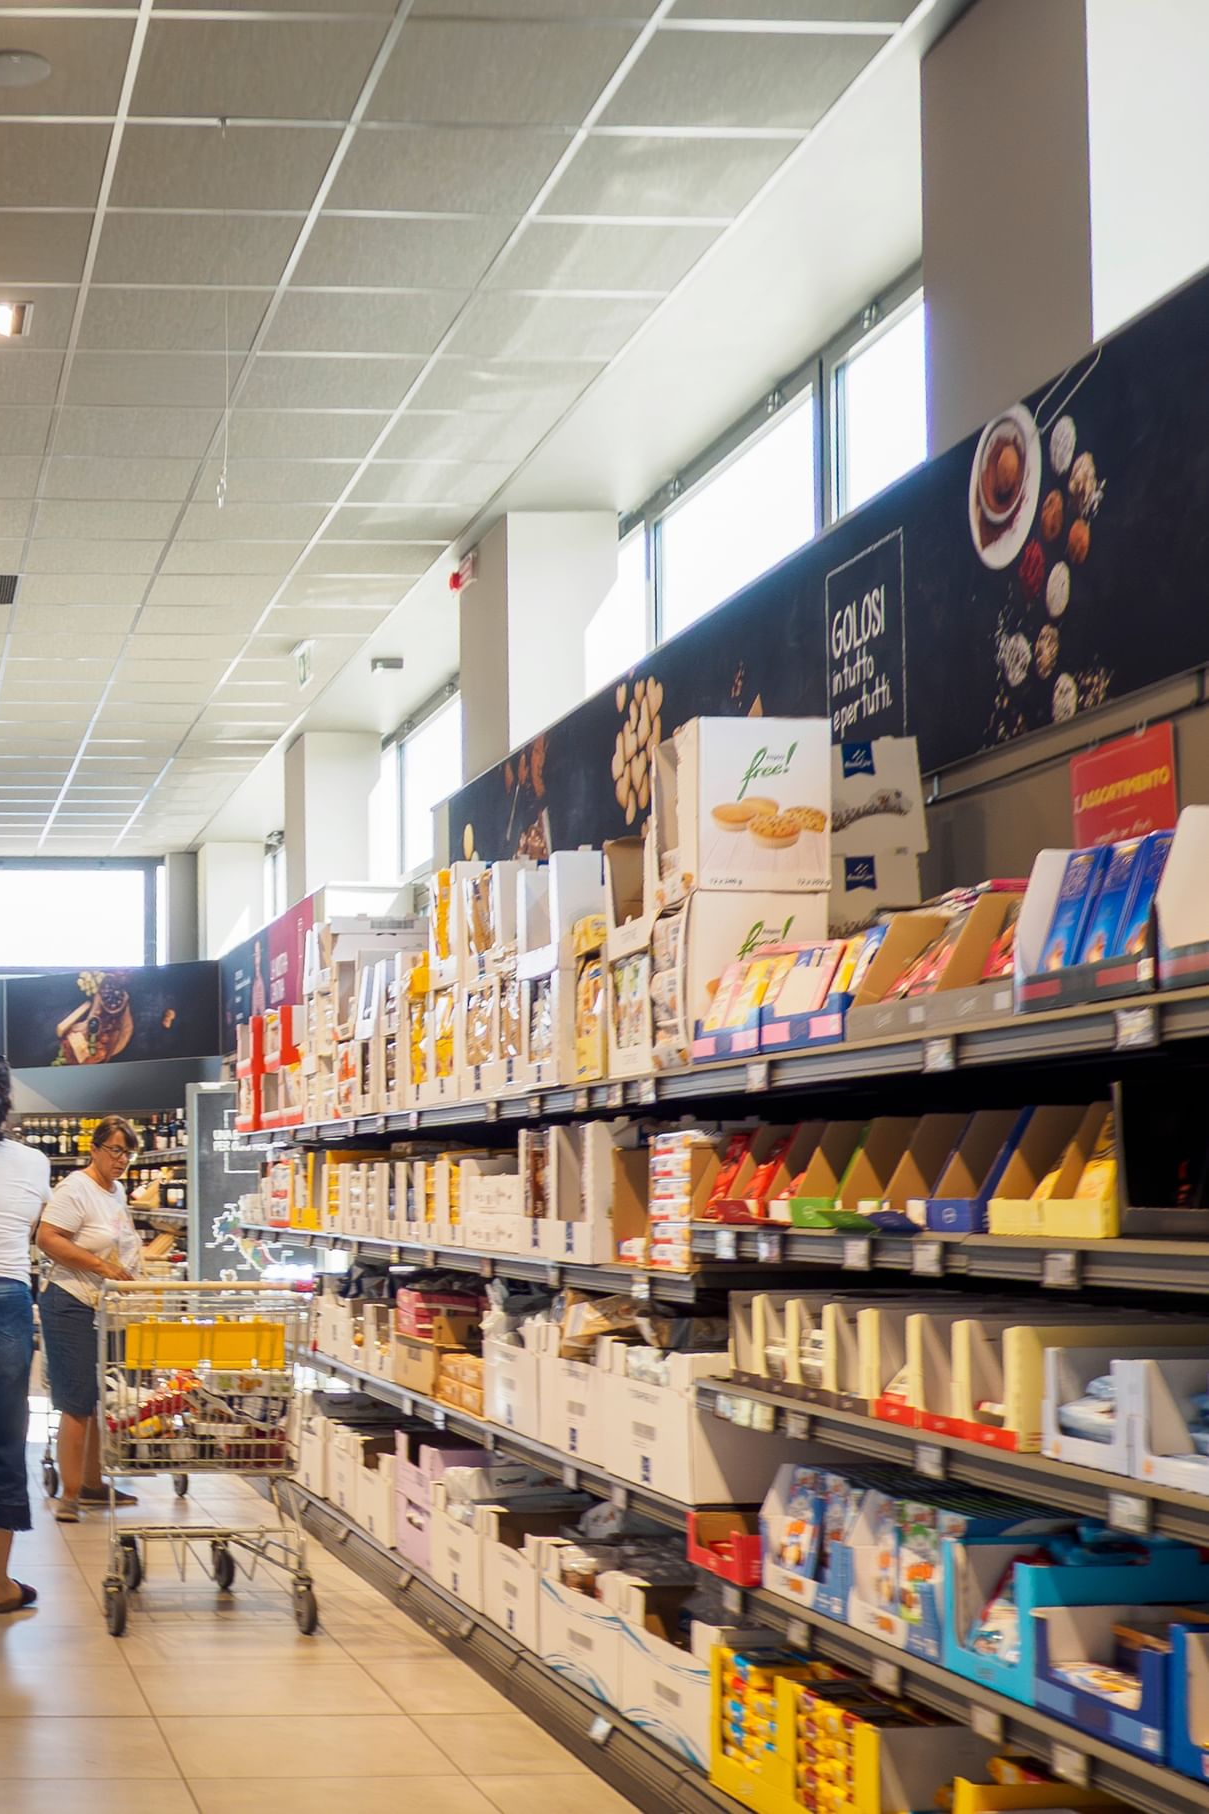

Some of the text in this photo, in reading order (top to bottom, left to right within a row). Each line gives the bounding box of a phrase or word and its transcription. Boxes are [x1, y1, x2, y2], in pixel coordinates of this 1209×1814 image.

[832, 584, 885, 660] GOLOSI
[843, 646, 875, 691] tutto
[840, 700, 861, 739] per
[737, 741, 797, 801] free!
